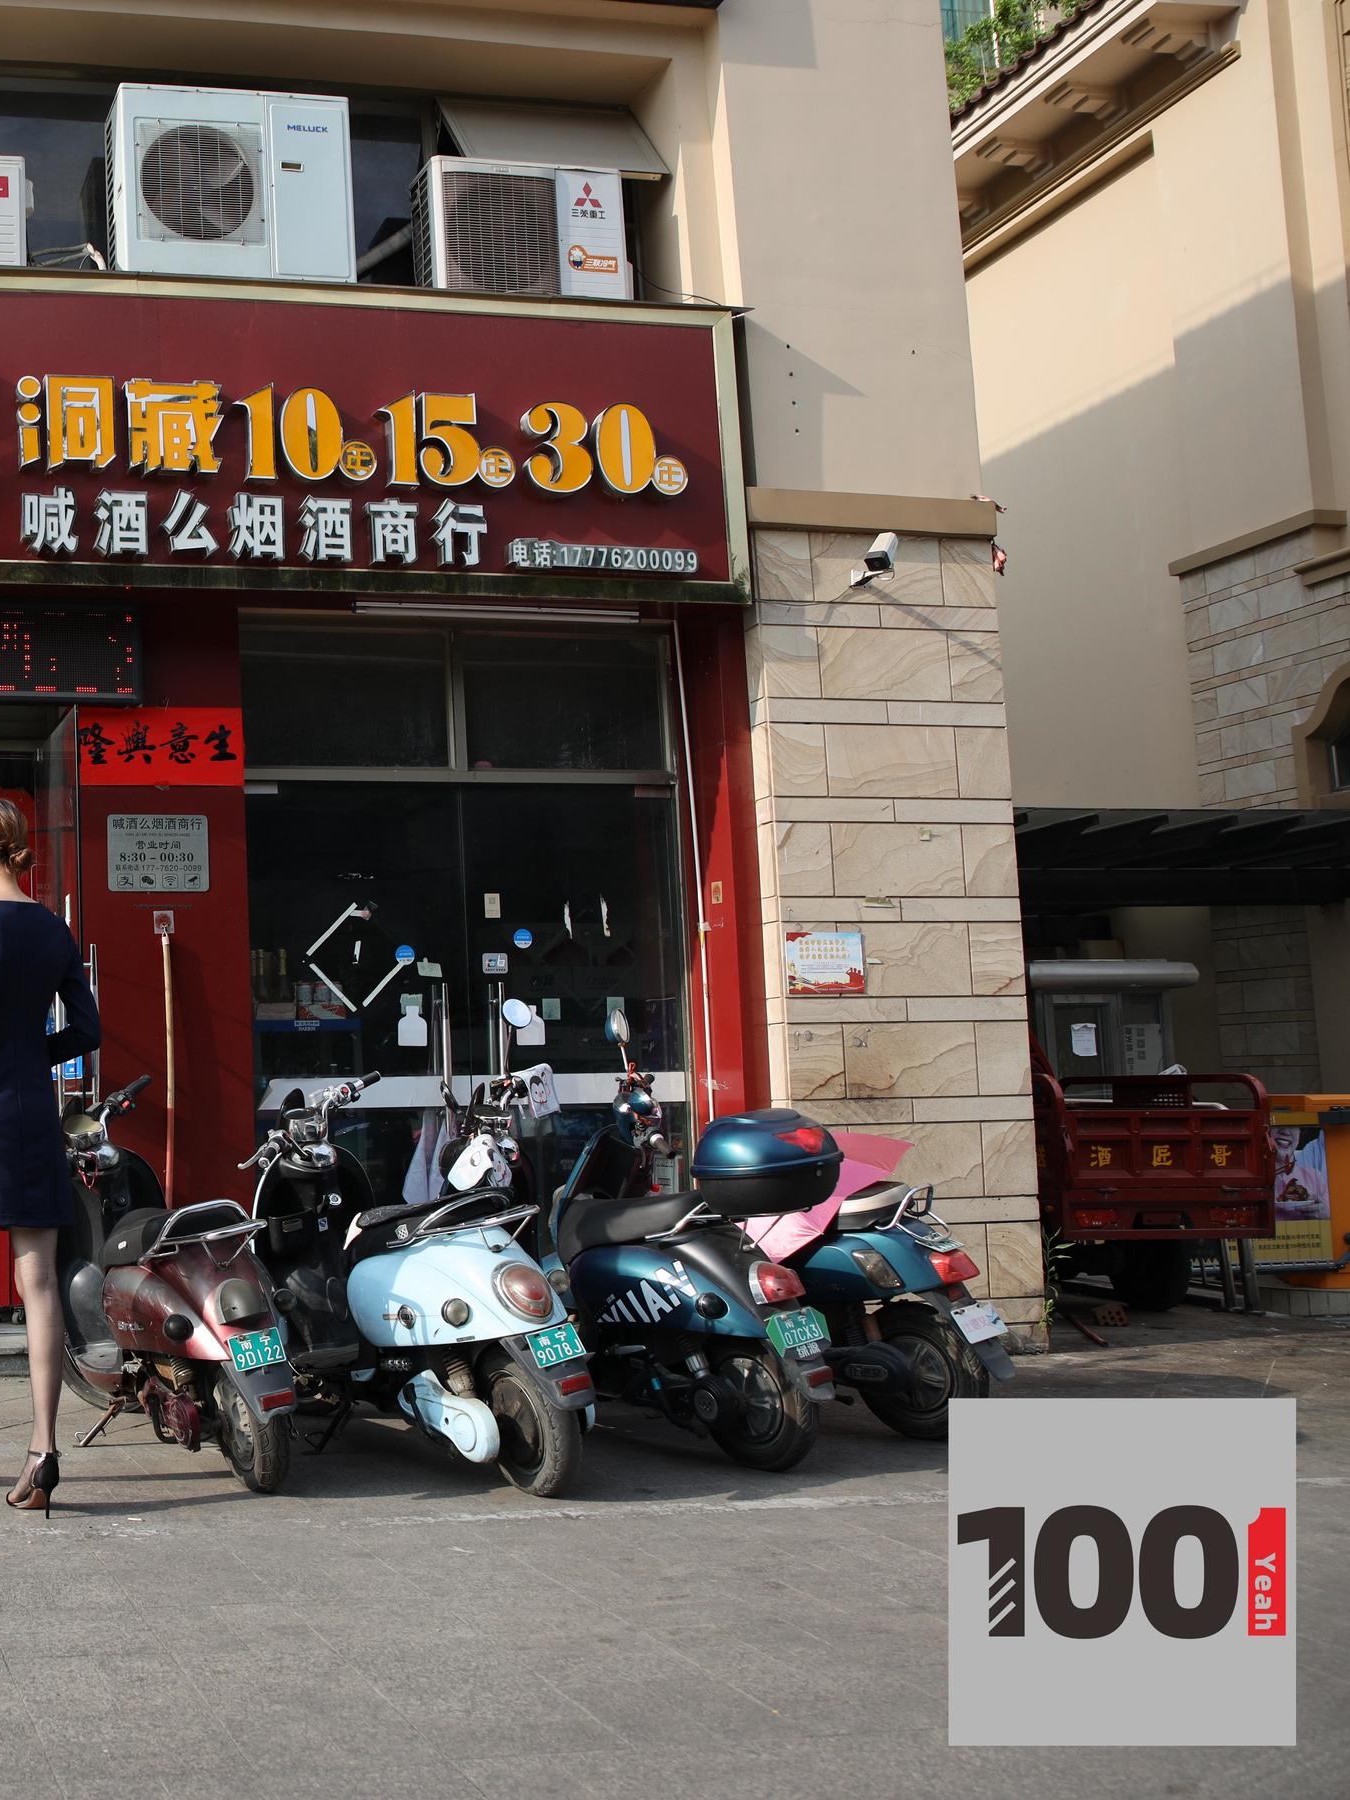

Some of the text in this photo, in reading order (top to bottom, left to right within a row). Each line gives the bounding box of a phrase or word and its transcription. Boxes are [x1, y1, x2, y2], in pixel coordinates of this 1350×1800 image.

[287, 124, 329, 133] MELUCK
[571, 208, 606, 220] 三菱重工
[21, 485, 488, 569] 喊酒么烟酒商行
[112, 817, 203, 831] 喊酒么烟酒商行
[135, 840, 182, 850] 营业时间
[119, 852, 146, 862] 8:30
[160, 852, 194, 862] 00:30
[1090, 1143, 1232, 1168] 酒匠哥
[537, 1331, 567, 1348] 南宁
[784, 1323, 820, 1346] 07CX3
[537, 1339, 582, 1364] 9078J
